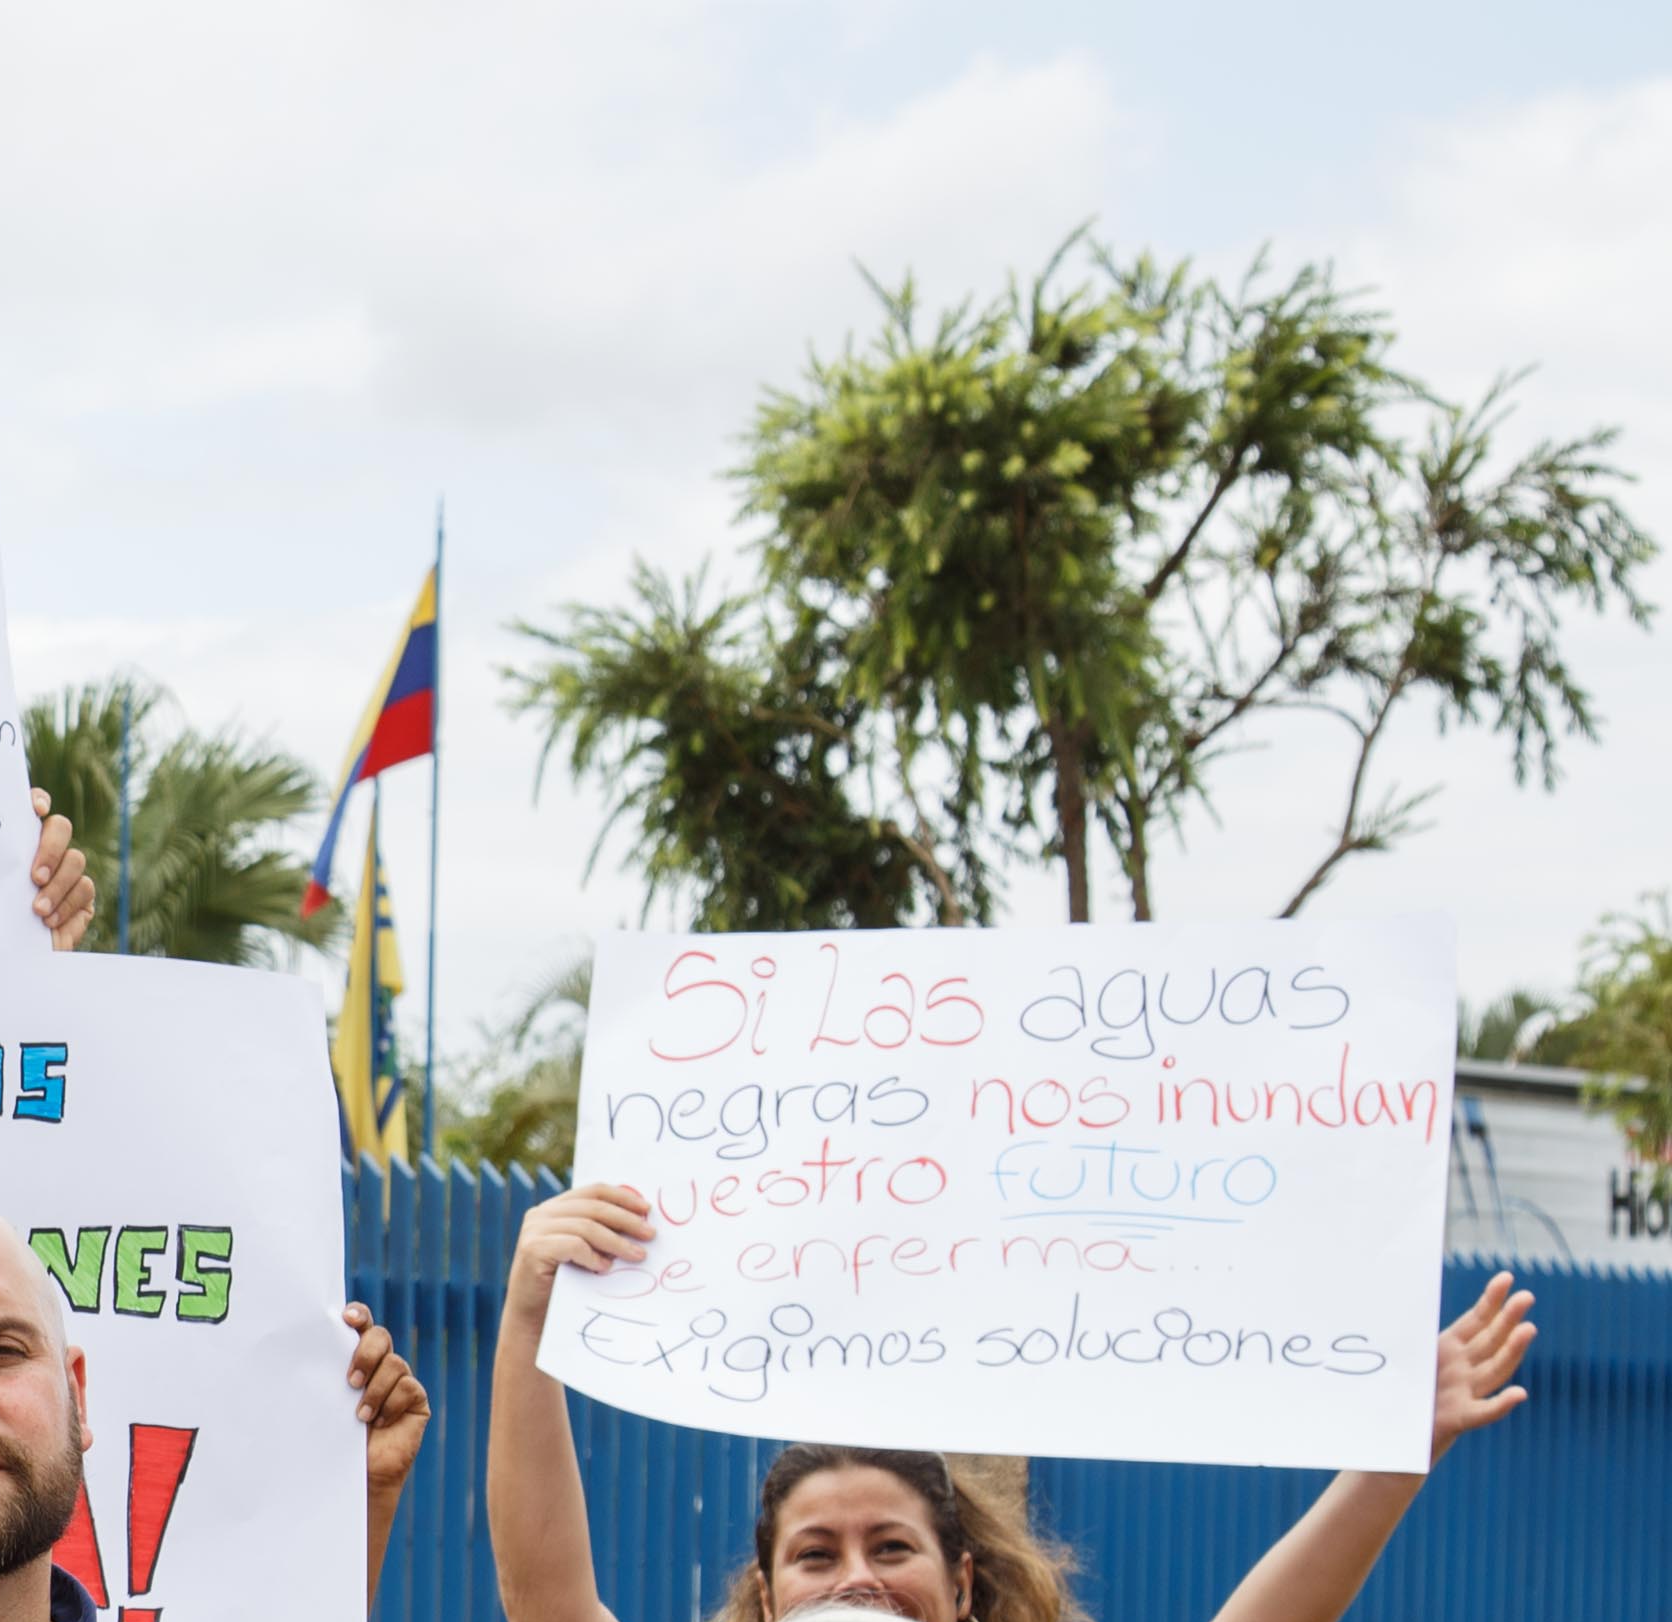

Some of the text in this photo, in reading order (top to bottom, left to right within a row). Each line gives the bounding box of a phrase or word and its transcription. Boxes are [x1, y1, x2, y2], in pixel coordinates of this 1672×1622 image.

[650, 943, 1350, 1061] Si Las aguas
[607, 1043, 1436, 1160] negras nos inundan
[576, 1293, 1386, 1402] Exigimos soluciones
